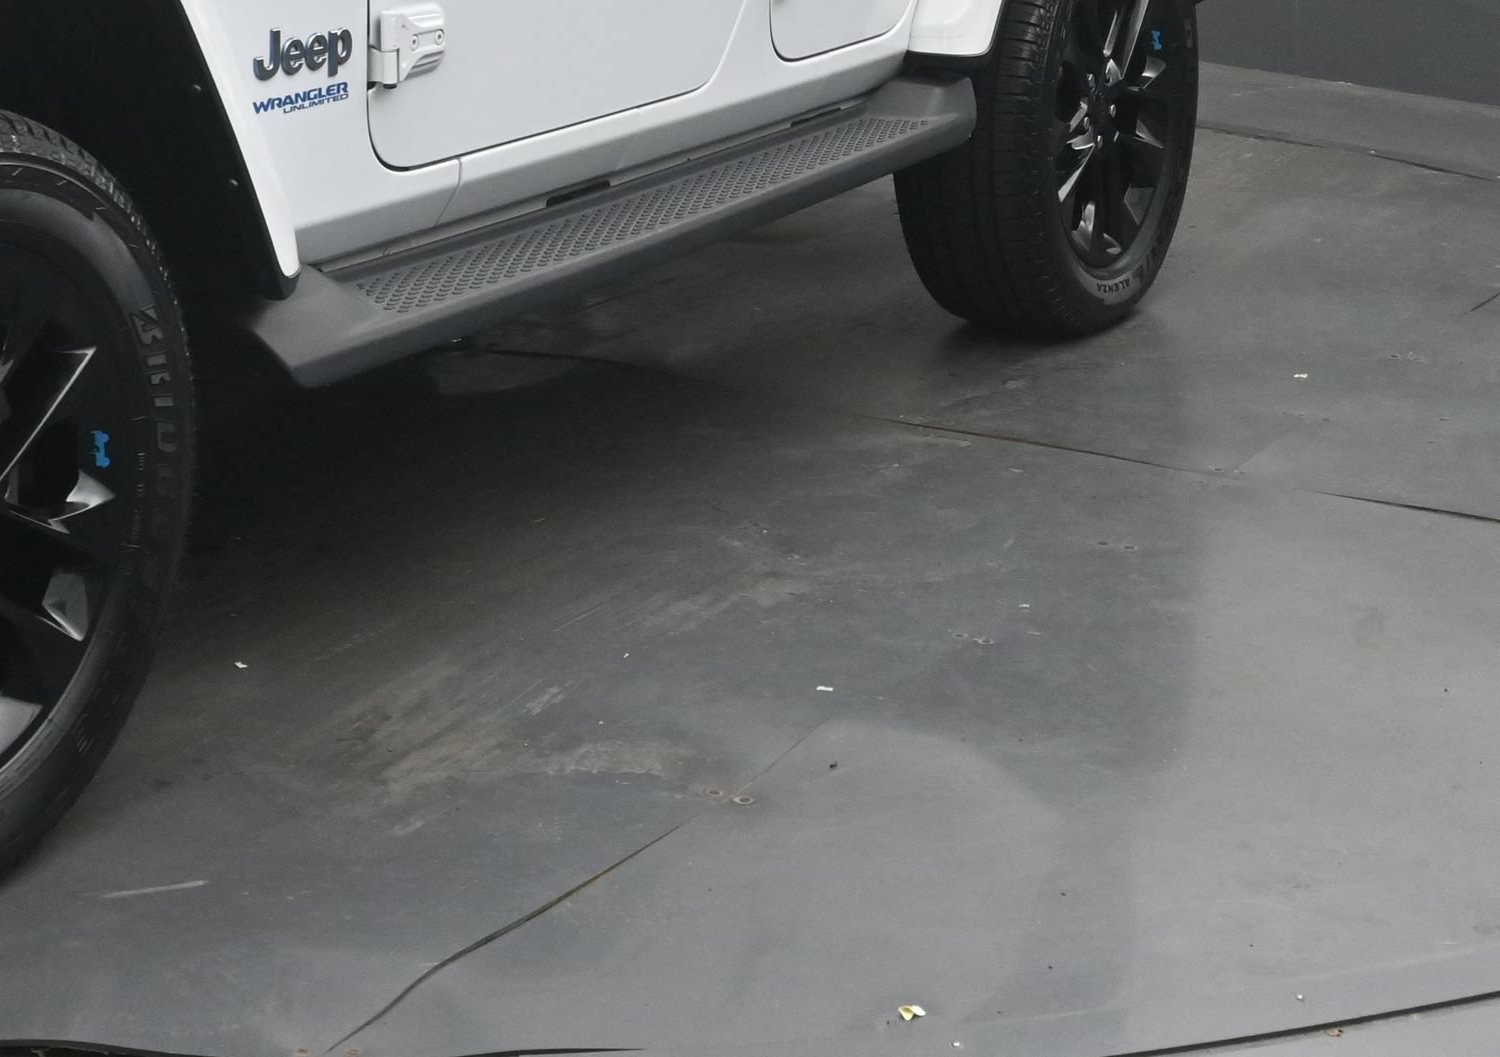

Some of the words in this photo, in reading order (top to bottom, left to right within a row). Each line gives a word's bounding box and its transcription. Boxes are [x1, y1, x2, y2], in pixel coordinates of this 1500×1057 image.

[253, 27, 352, 81] Jeep
[252, 81, 349, 114] WRANGLER
[283, 93, 349, 114] UNLIMITED
